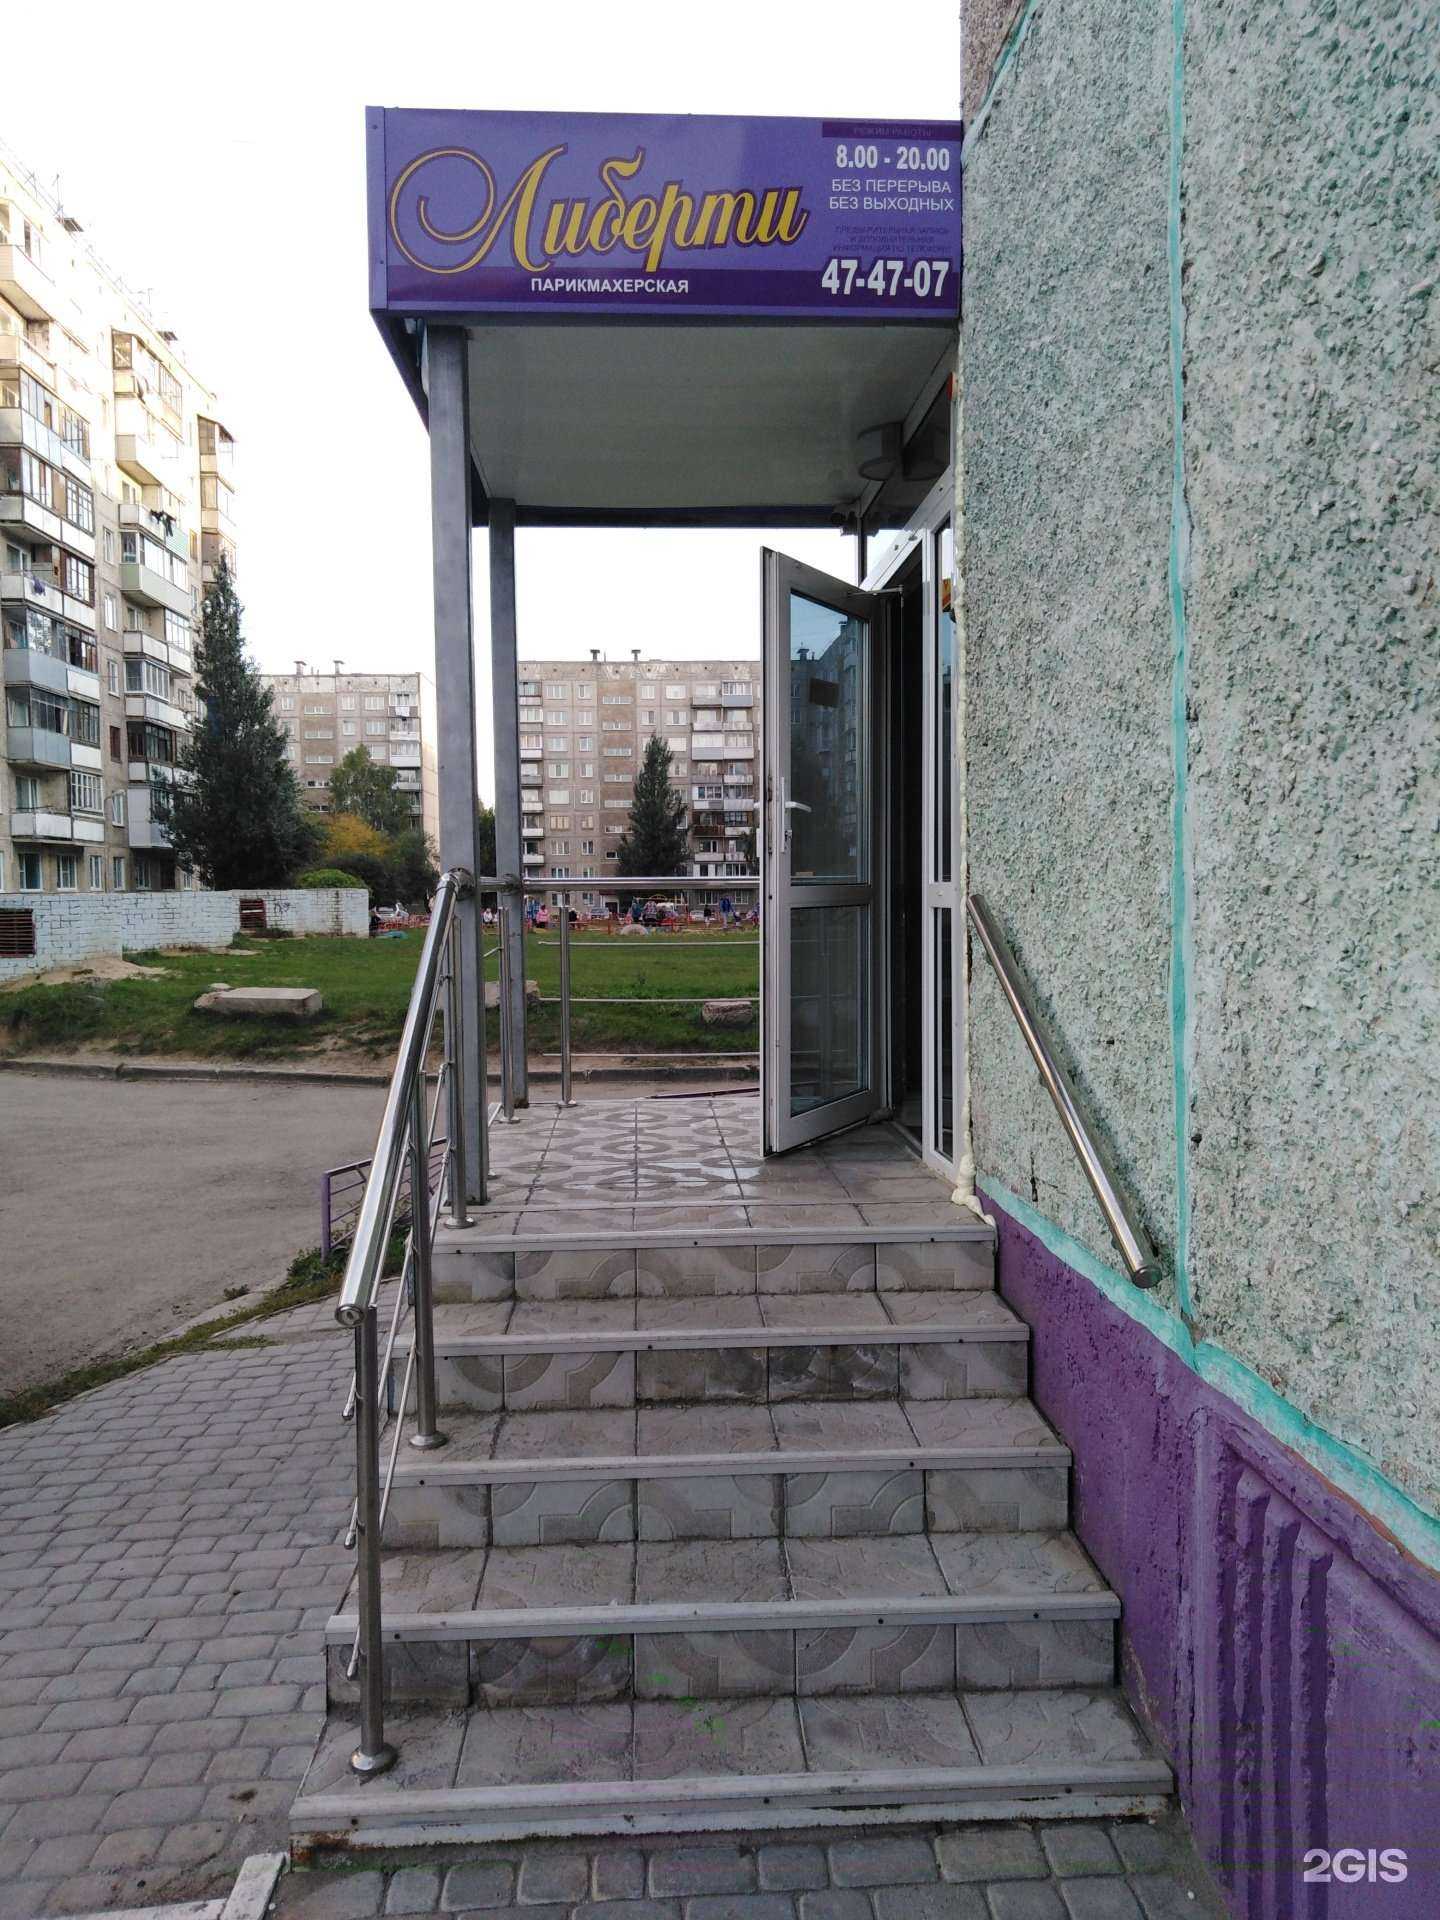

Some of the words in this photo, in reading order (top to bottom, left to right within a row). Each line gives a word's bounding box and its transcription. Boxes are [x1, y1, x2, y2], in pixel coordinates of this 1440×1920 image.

[836, 144, 878, 169] 8.00
[896, 146, 950, 171] 20.00
[832, 178, 861, 192] БЕЗ
[866, 179, 952, 194] ПЕРЕРЫВА
[388, 143, 810, 273] Либерти
[829, 196, 859, 210] БЕЗ
[863, 197, 954, 212] ВЫХОДНЫХ
[530, 276, 690, 295] ПАРИКМАХЕРСКАЯ
[821, 258, 950, 297] 47-47-07
